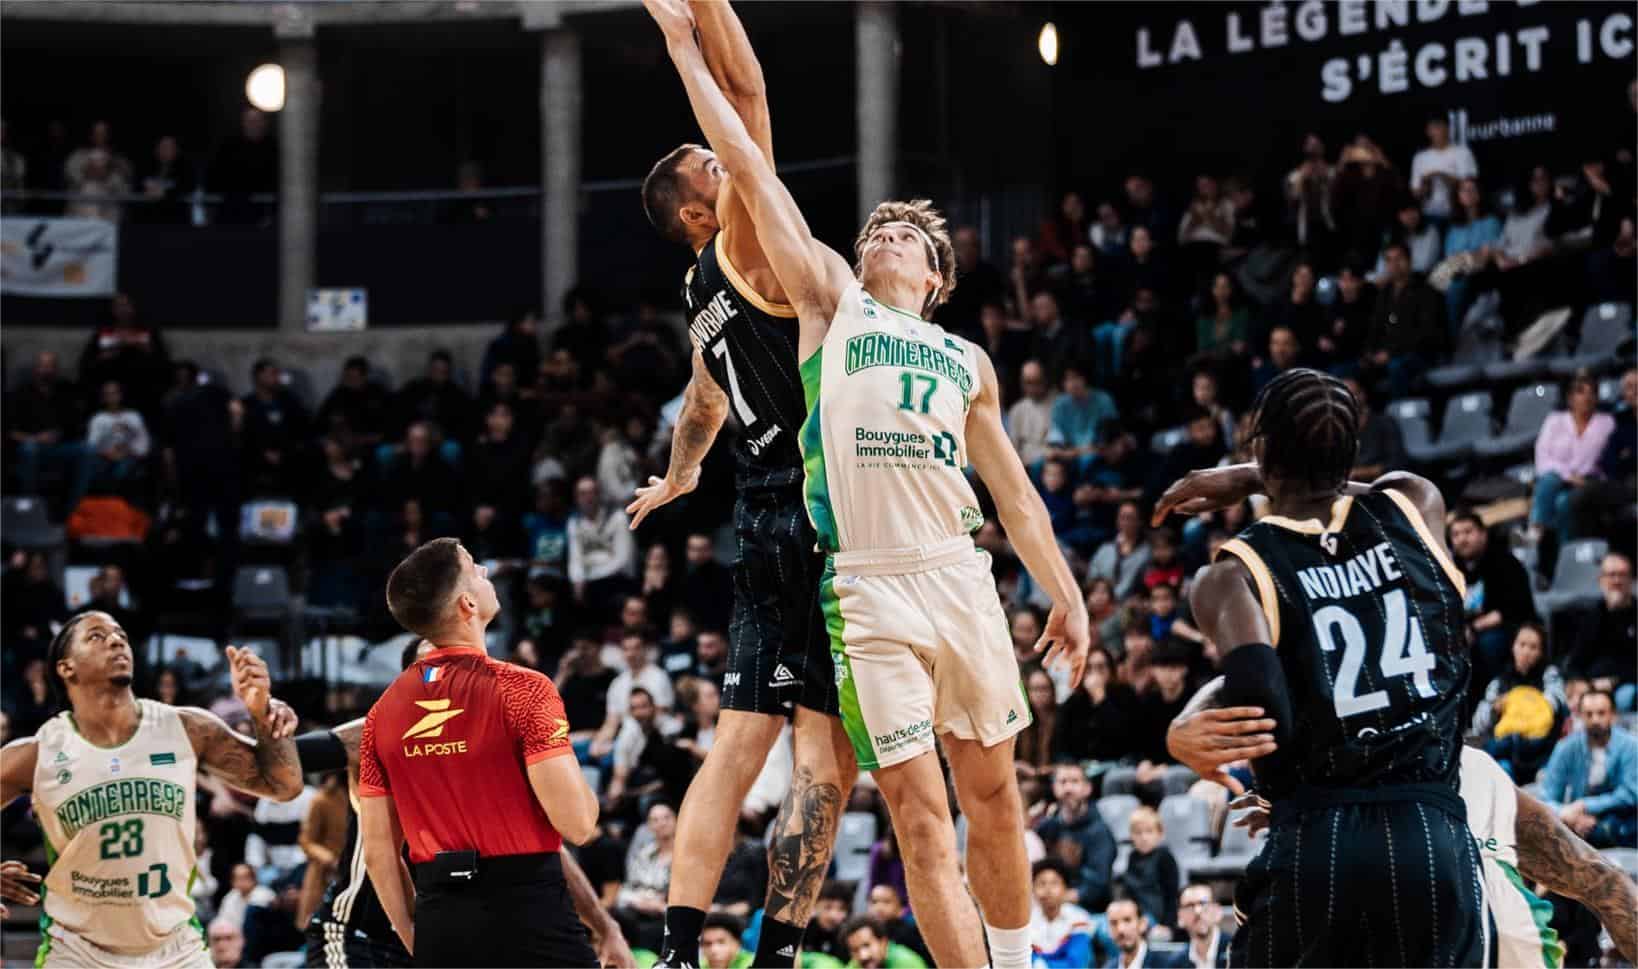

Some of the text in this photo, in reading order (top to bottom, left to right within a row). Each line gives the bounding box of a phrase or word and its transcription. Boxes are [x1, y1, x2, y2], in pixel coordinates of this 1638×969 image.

[1136, 20, 1202, 69] LA
[711, 337, 757, 427] 7
[898, 371, 938, 415] 17
[856, 428, 926, 444] Bouygues
[856, 444, 930, 459] Immobilier
[1296, 541, 1402, 601] NDIAYE
[1312, 588, 1439, 719] 24
[404, 741, 468, 757] LA POSTE
[56, 778, 186, 840] NANTERRE92
[99, 817, 145, 861] 23
[70, 870, 131, 887] Bouygues
